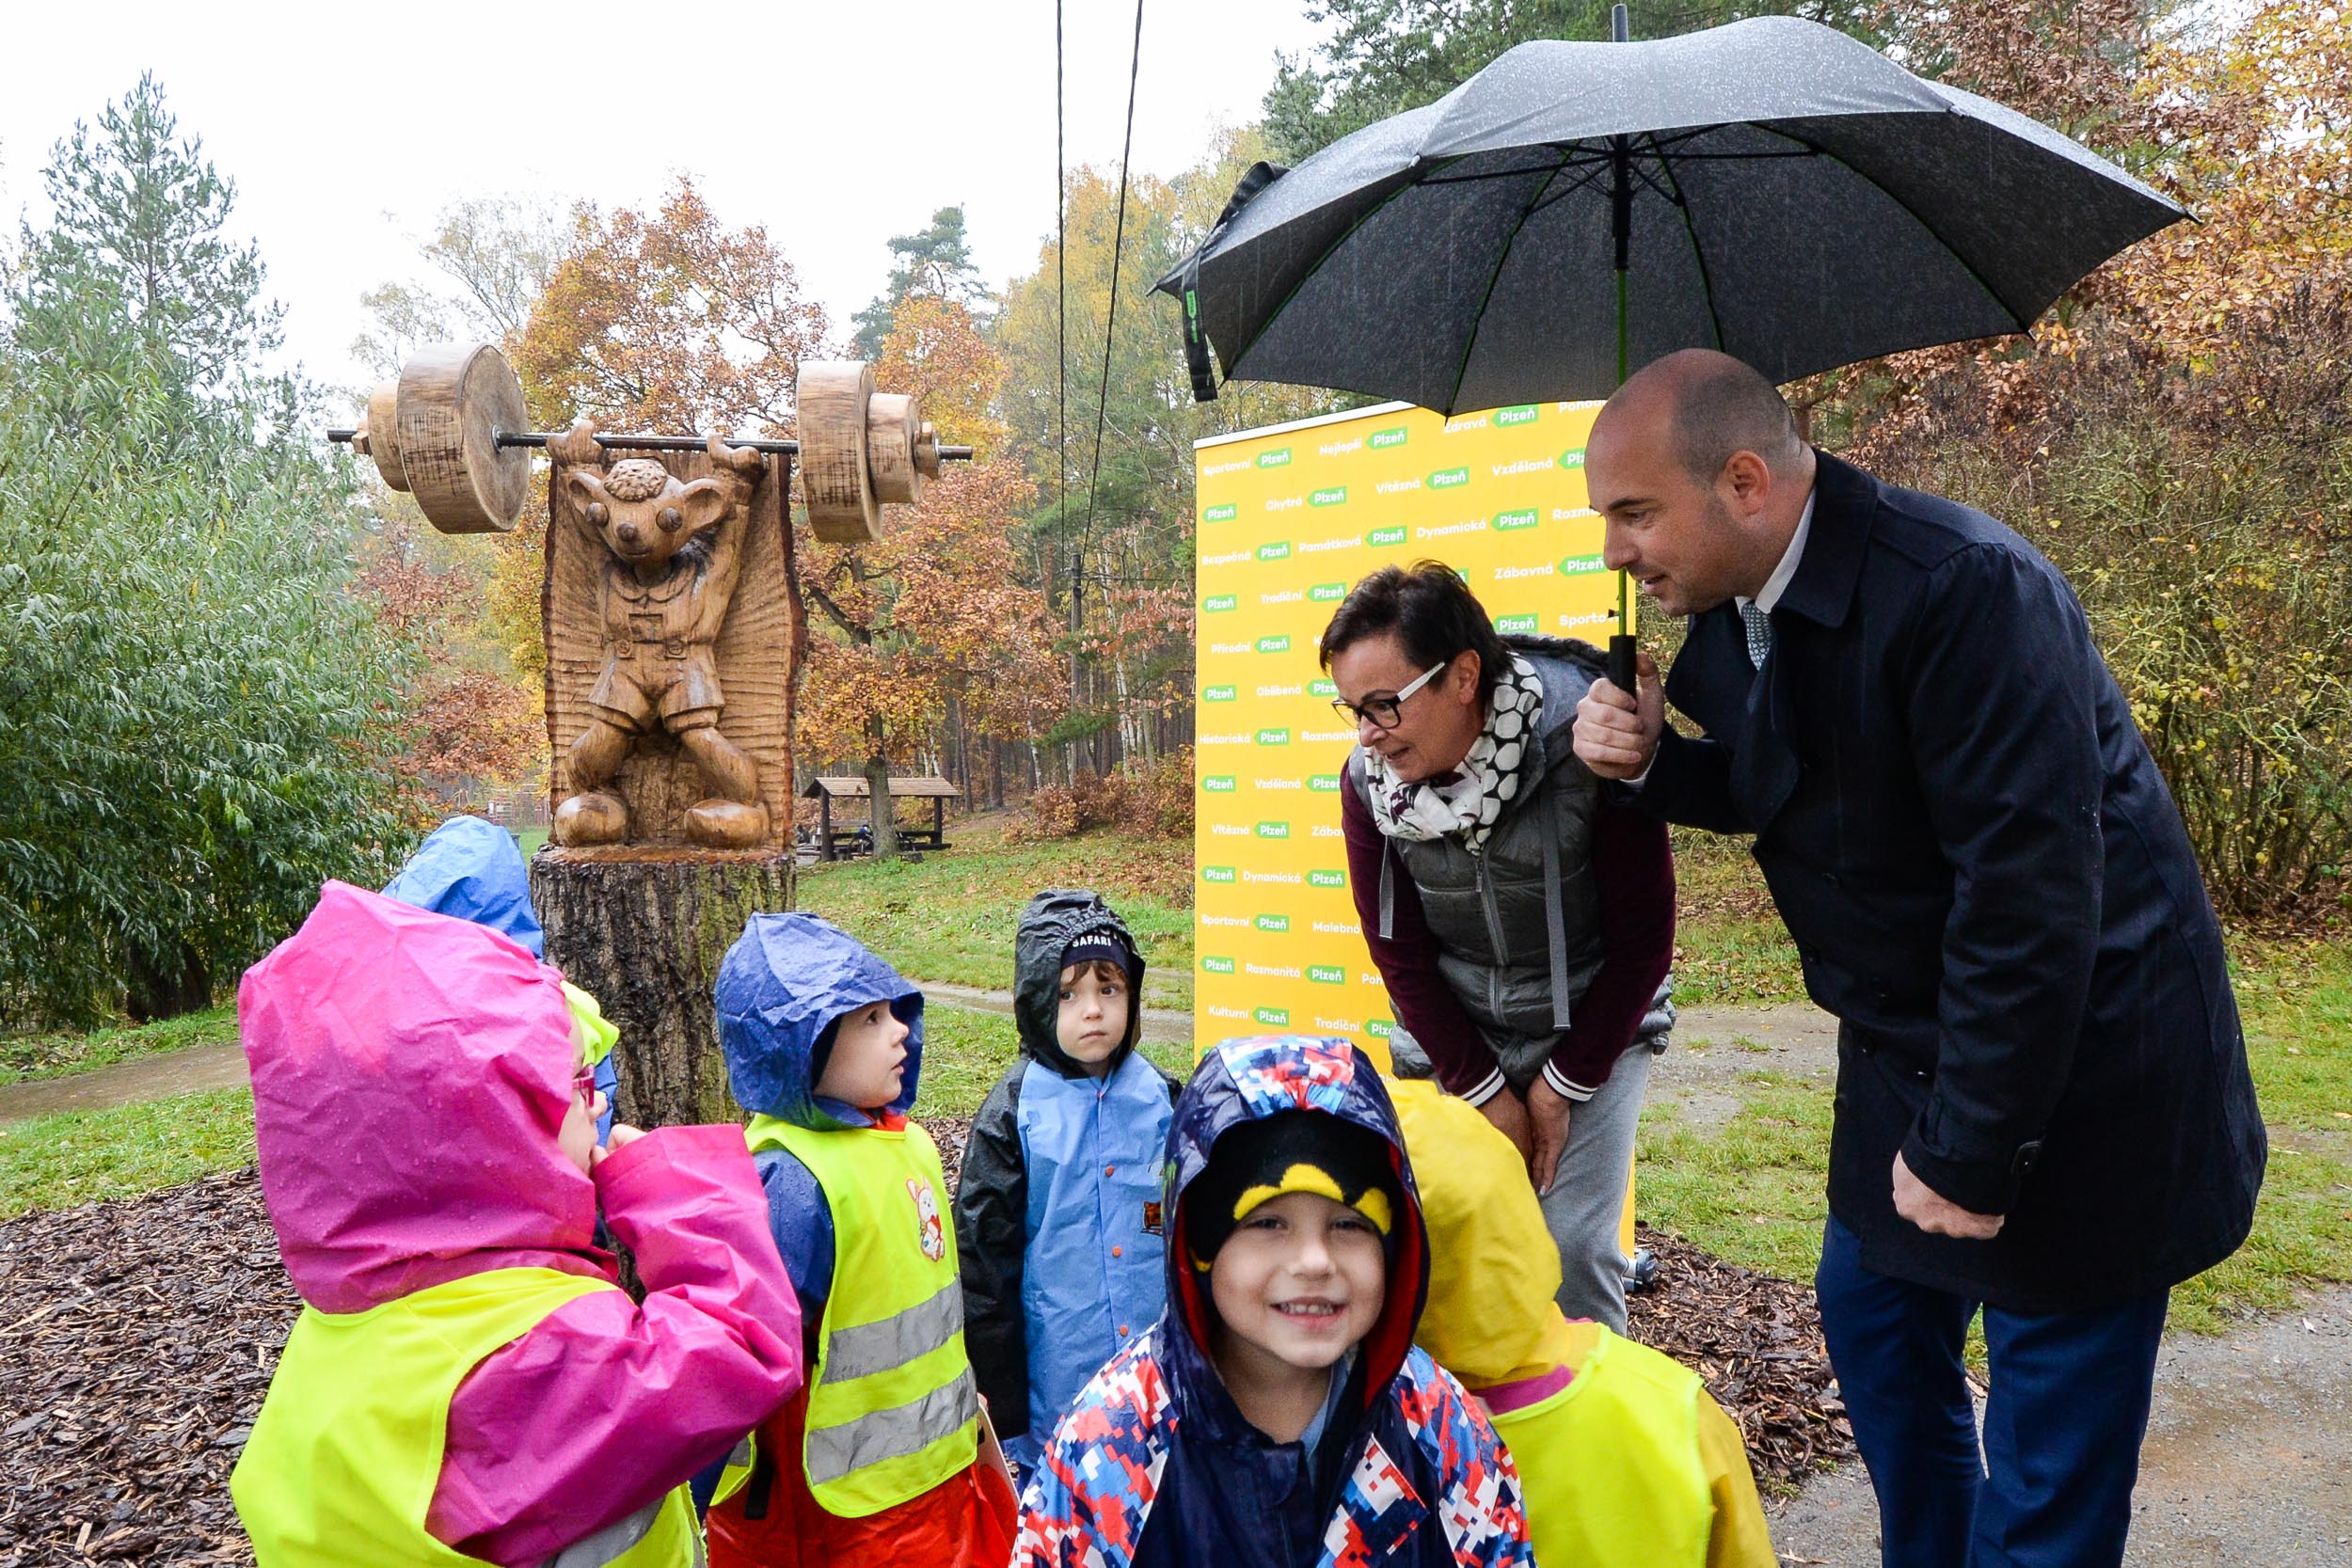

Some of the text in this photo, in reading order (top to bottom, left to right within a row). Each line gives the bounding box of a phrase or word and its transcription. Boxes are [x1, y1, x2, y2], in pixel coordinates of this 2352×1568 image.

[1442, 406, 1535, 435] Zdravá Plzeň
[1318, 430, 1406, 456] Nejlepší Plzeň
[1202, 451, 1289, 478] Sportovní Plzeň
[1491, 451, 1585, 477] Vzdělaná Plz
[1433, 469, 1467, 487] Plzeň
[1264, 488, 1344, 512] Chytrá Plzeň
[1206, 505, 1235, 520] Plzeň
[1416, 511, 1535, 541] Dynamická Plzeň
[1297, 529, 1405, 553] Památková Plzeň
[1200, 544, 1288, 566] Bezpečná Plzeň
[1494, 556, 1605, 580] Zábavná Plzeň
[1206, 596, 1234, 610] Plzeň
[1260, 585, 1344, 605] Tradiční Plzeň
[1498, 617, 1536, 632] Plzeň
[1260, 637, 1288, 651] Plzeň
[1206, 688, 1234, 700] Plzeň
[1198, 731, 1288, 745] Historická Plzeň
[1206, 778, 1233, 790] Plzeň
[1254, 778, 1302, 789] Vzdělaná
[1260, 824, 1287, 836] Plzeň
[1205, 868, 1233, 881] Plzeň
[1242, 870, 1343, 886] Dynamická Plzeň
[1200, 913, 1287, 930] Sportovní Plzeň
[1312, 921, 1361, 935] Malebná
[1072, 935, 1112, 948] SAFARI
[1205, 958, 1232, 972] Plzeň
[1245, 962, 1343, 982] Rozmanitá Plzeň
[1208, 1005, 1287, 1024] Kulturní Plzeň
[1313, 1016, 1393, 1037] Tradiční Plz
